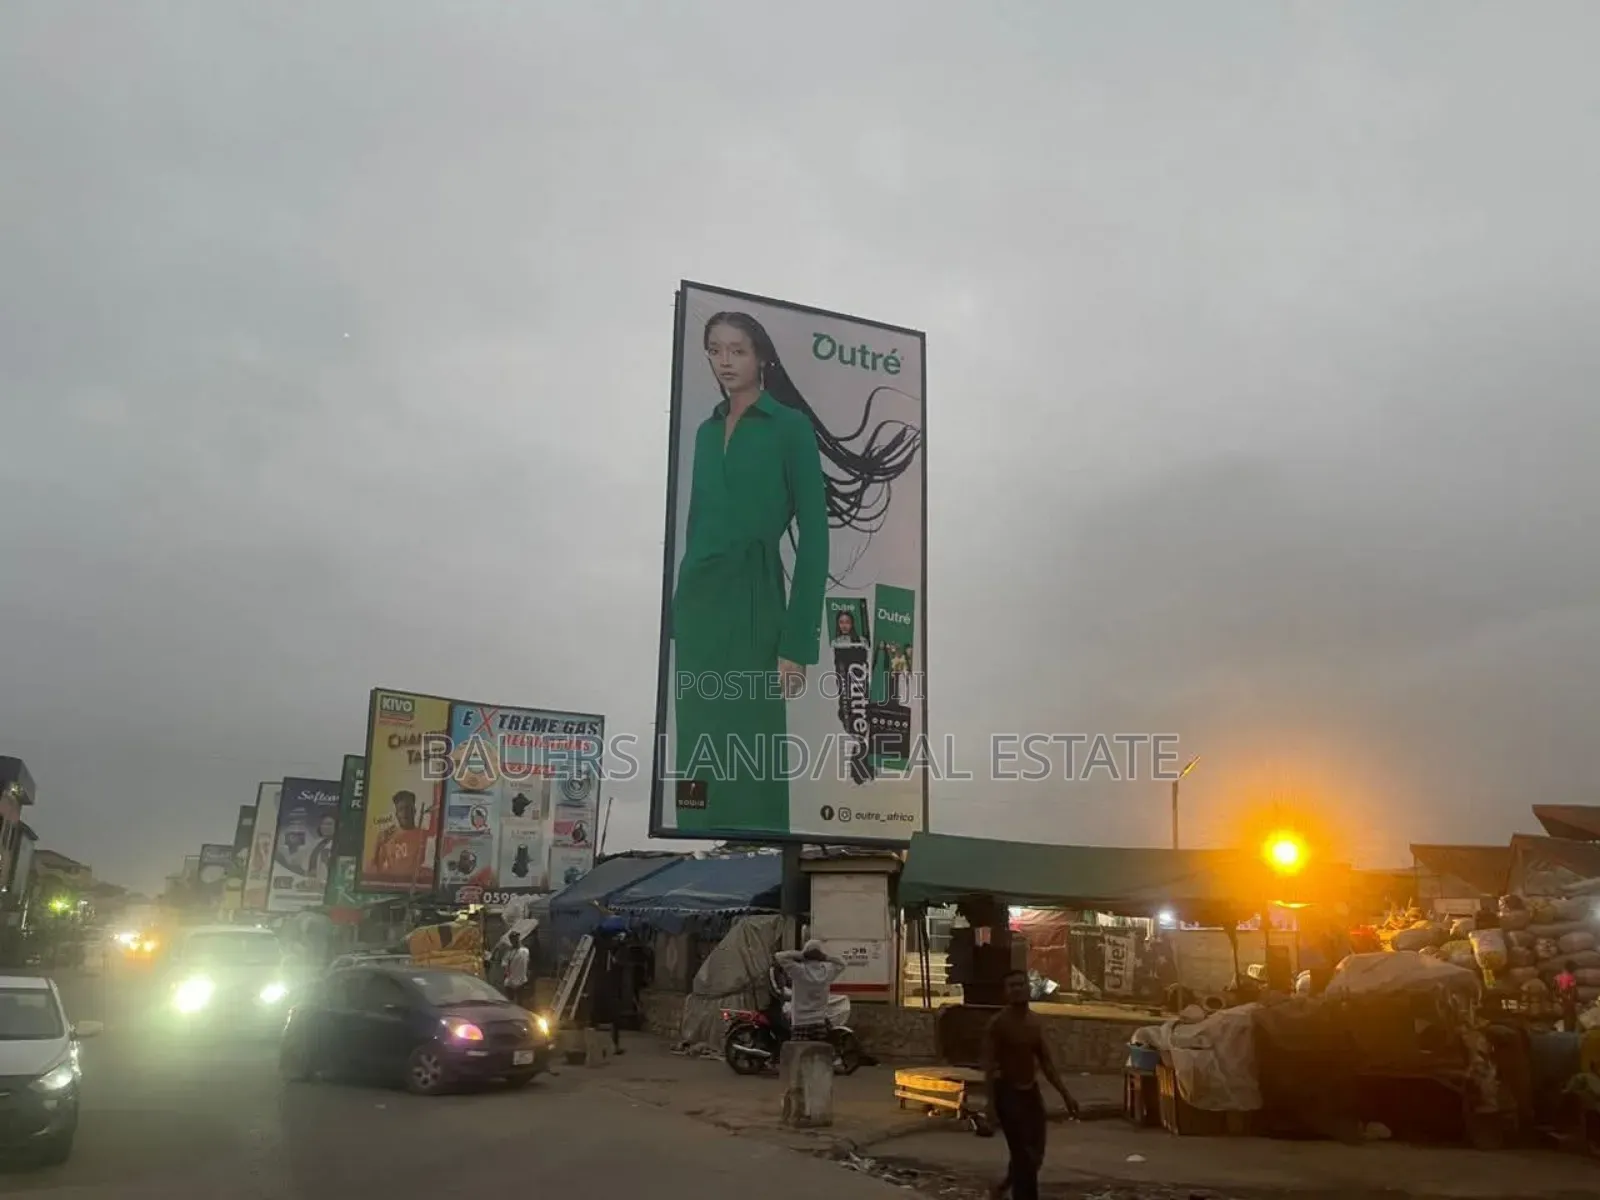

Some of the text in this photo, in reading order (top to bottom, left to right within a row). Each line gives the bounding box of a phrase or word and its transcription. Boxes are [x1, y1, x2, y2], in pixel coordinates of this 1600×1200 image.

[382, 697, 413, 712] KIVO
[462, 704, 600, 737] EXTREME GAS
